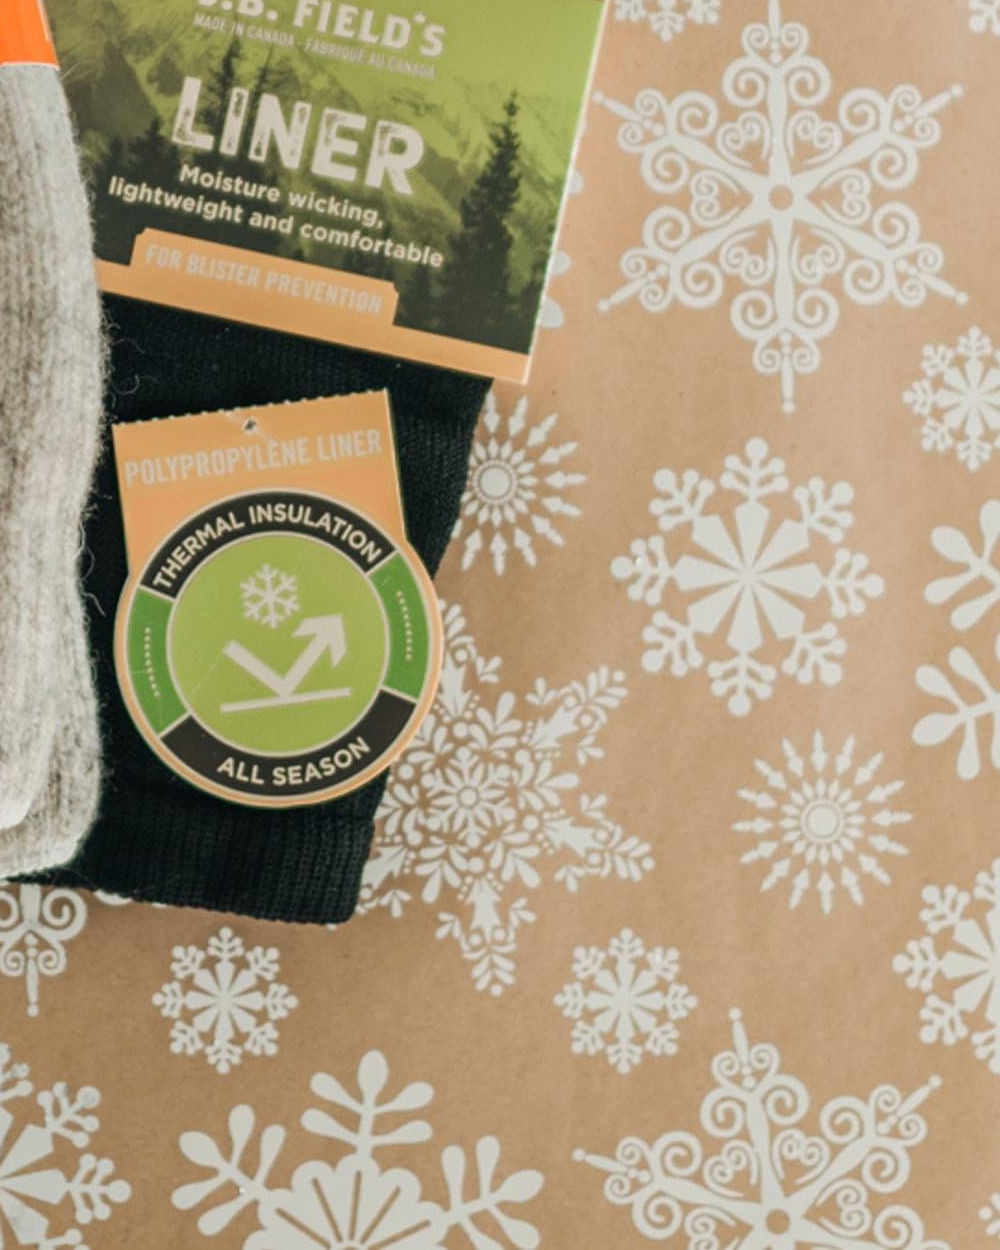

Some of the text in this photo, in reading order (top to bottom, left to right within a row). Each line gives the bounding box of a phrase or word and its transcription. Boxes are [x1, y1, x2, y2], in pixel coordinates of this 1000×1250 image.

[193, 13, 226, 34] MADE
[230, 21, 244, 36] IN
[246, 25, 295, 48] CANADA
[367, 51, 385, 69] AU
[386, 58, 437, 80] CANADA
[171, 76, 424, 195] LINER
[108, 176, 444, 268] lightweight and comfortable
[179, 164, 384, 229] Moisture wicking,
[144, 243, 384, 315] FOR BLISTER PREVENTION
[316, 429, 383, 461] LINER
[152, 502, 383, 588] THERMAL INSULATION
[217, 736, 371, 786] ALL SEASON
